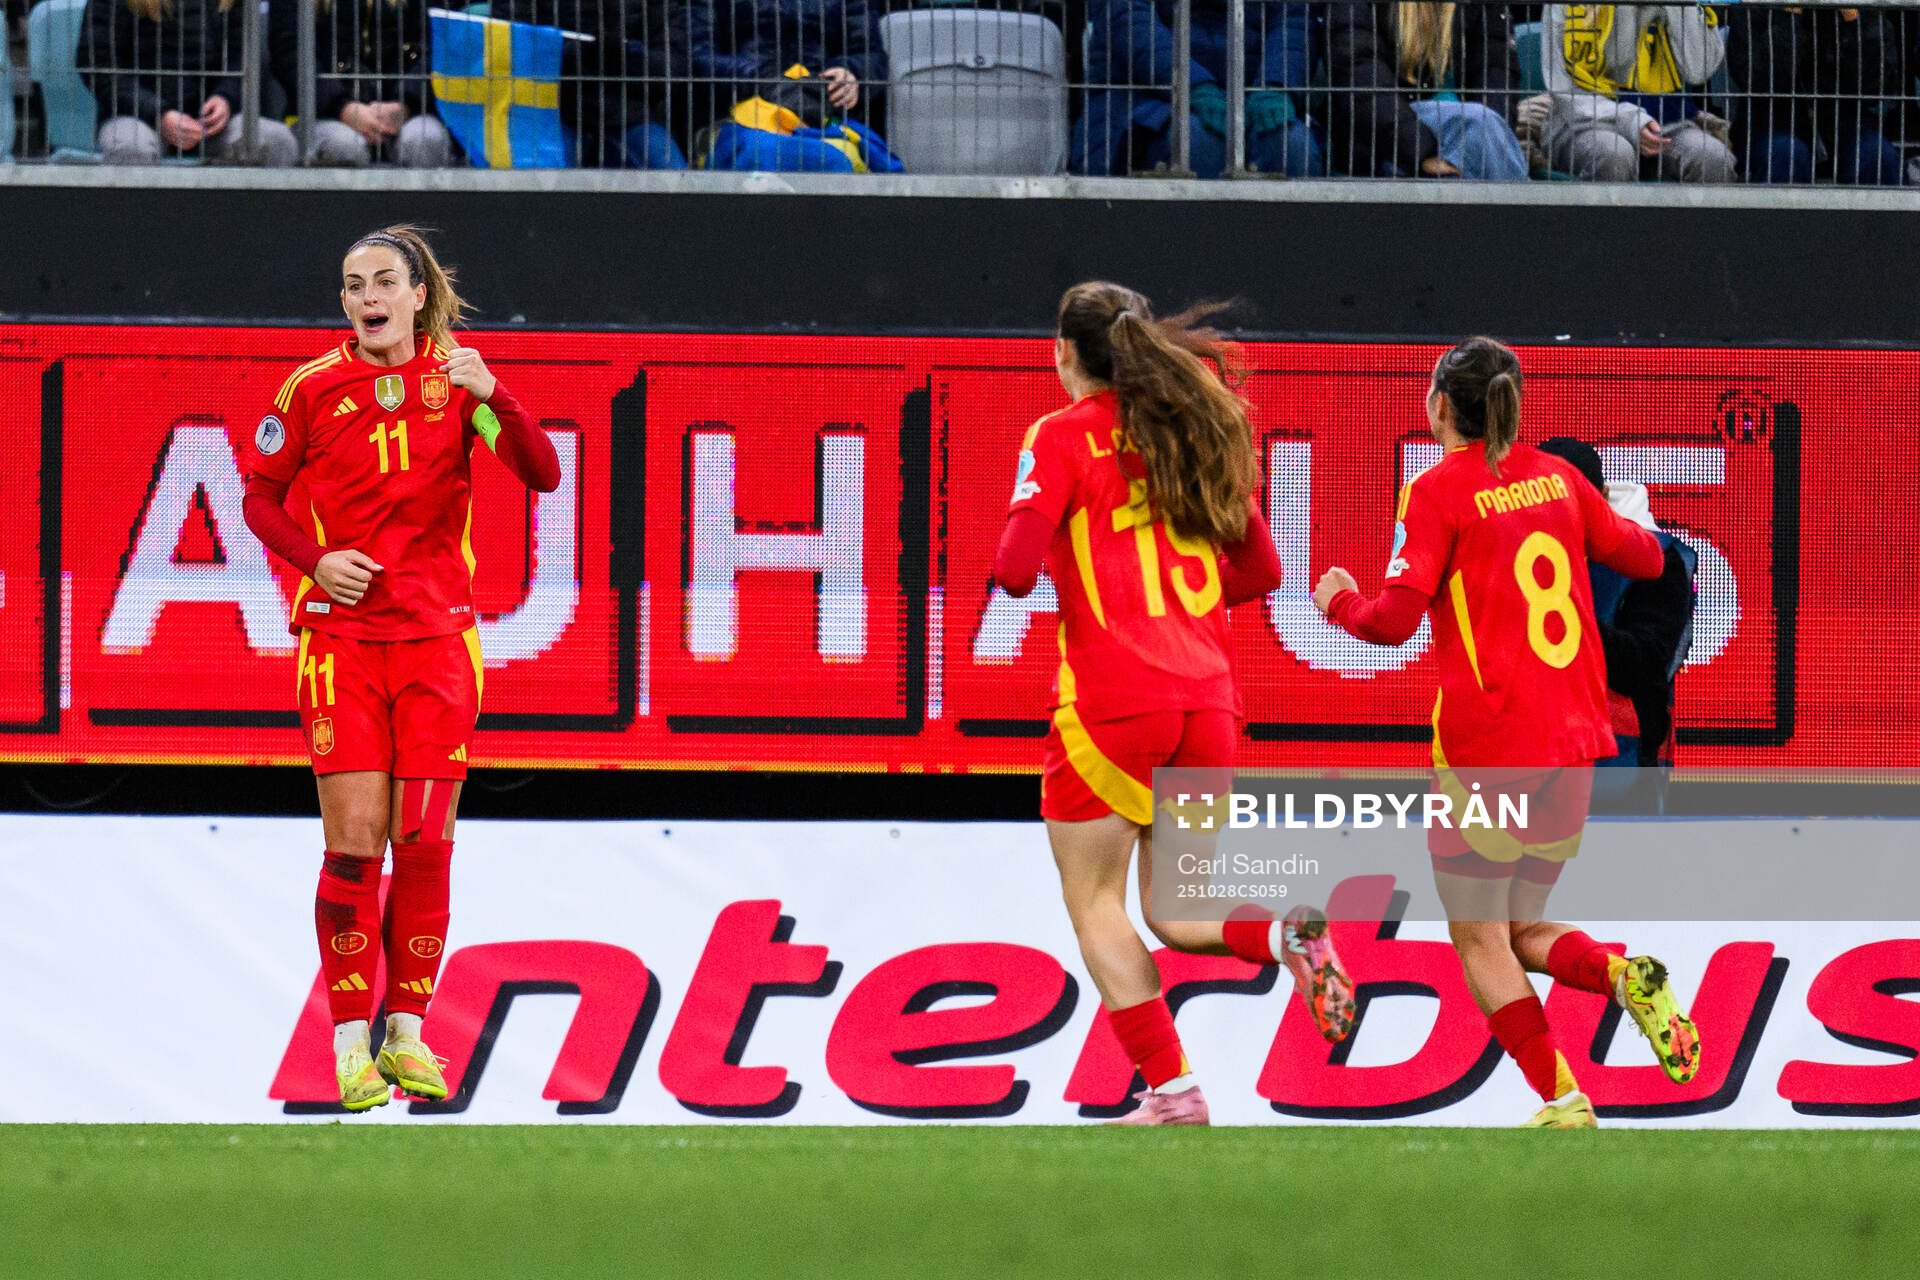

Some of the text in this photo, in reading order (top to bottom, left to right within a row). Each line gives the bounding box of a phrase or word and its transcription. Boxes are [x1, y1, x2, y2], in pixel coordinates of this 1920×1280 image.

[369, 420, 409, 473] 11
[1474, 473, 1569, 519] MARIONA
[1514, 530, 1582, 669] 8
[303, 653, 335, 708] 11
